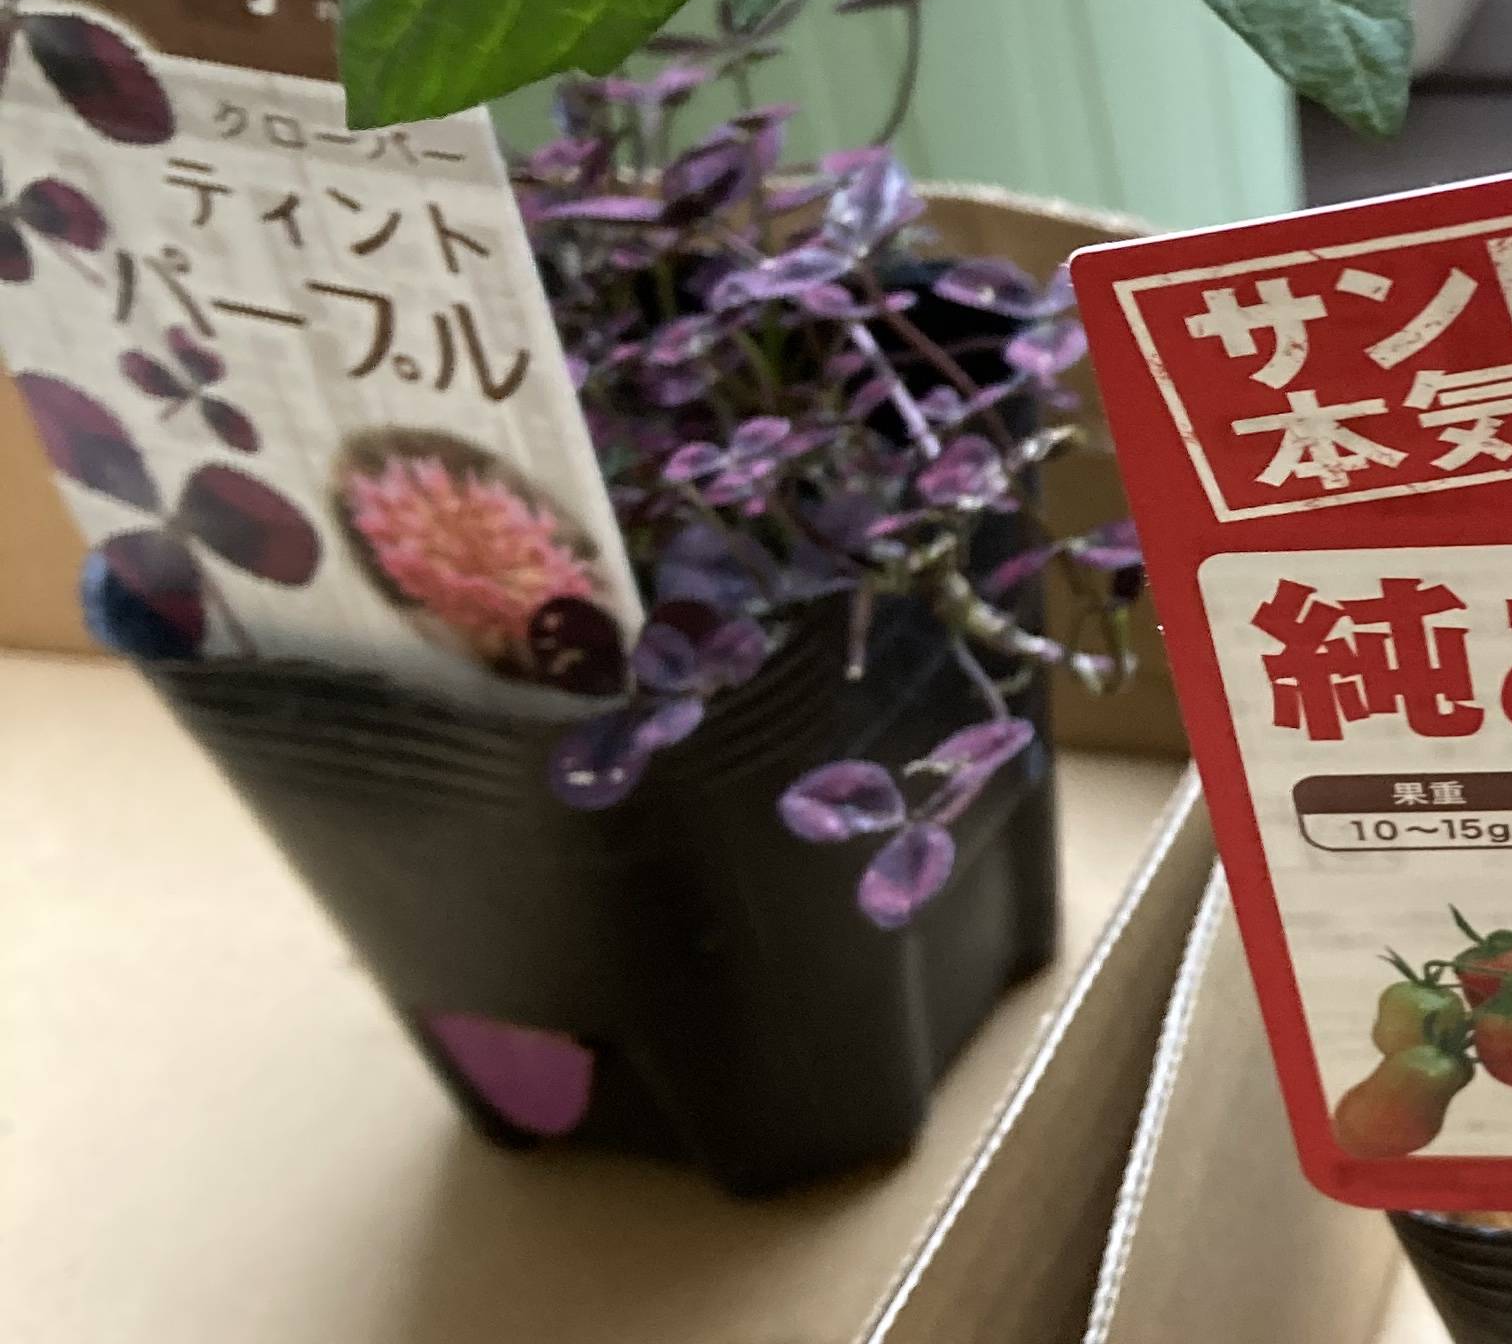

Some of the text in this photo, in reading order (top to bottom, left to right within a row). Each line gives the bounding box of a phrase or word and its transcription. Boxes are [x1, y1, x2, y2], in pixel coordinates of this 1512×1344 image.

[165, 160, 490, 274] ティント
[115, 248, 530, 402] パープル
[1393, 781, 1467, 806] 果重
